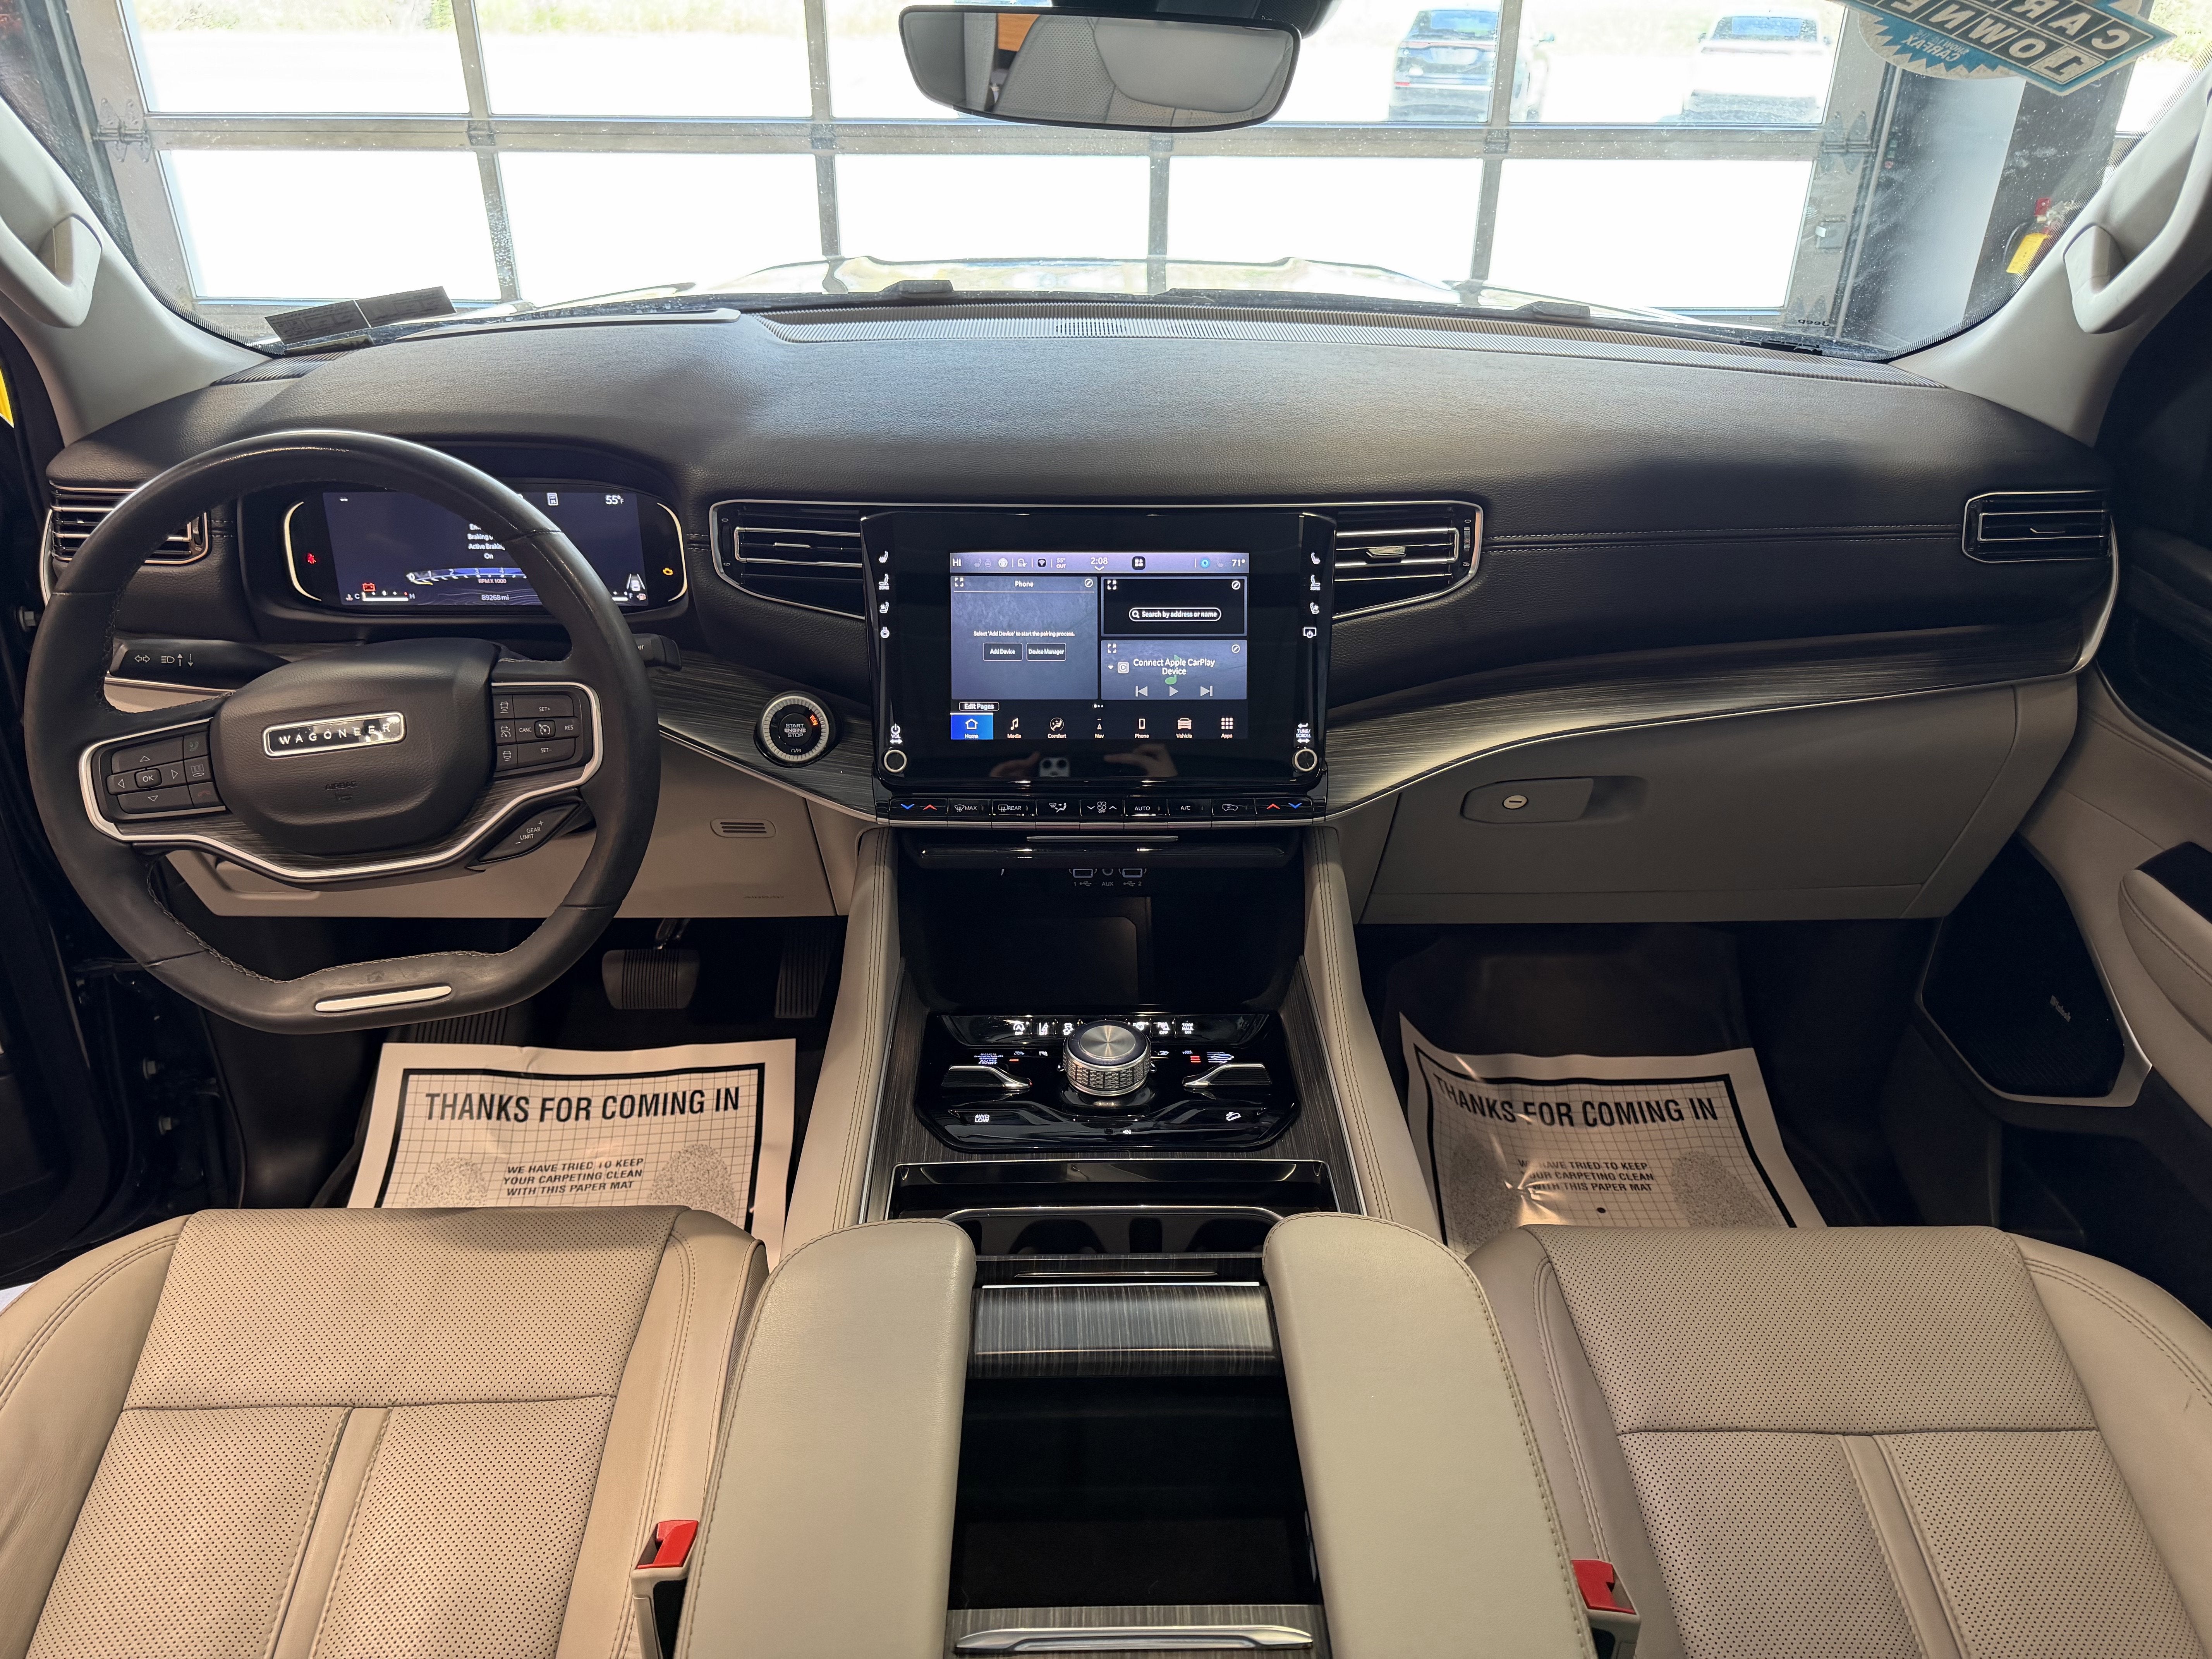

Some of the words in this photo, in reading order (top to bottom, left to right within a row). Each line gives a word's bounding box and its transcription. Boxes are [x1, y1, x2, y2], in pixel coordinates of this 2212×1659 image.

[1165, 658, 1186, 667] Apple
[1187, 658, 1215, 668] CarPlay
[279, 723, 391, 745] WAGONEER
[326, 781, 357, 790] AIRBAG
[426, 1092, 529, 1123] THANKS
[540, 1096, 591, 1123] FOR
[602, 1089, 704, 1119] COMING
[715, 1086, 740, 1112] IN
[1433, 1073, 1516, 1123] THANKS
[1523, 1101, 1575, 1127] FOR
[1582, 1098, 1684, 1127] COMING
[1690, 1097, 1718, 1121] IN
[528, 1164, 558, 1173] HAVE
[562, 1162, 593, 1171] TRIED
[598, 1161, 612, 1169] TO
[616, 1158, 644, 1168] KEEP
[1569, 1161, 1601, 1170] TRIED
[1604, 1162, 1618, 1170] TO
[504, 1176, 535, 1185] YOUR
[539, 1171, 602, 1183] CARPETING
[606, 1169, 642, 1179] CLEAN
[1555, 1172, 1618, 1180] CARPETING
[1619, 1173, 1654, 1181] CLEAN
[507, 1187, 536, 1196] WITH
[541, 1185, 566, 1194] THIS
[570, 1183, 606, 1192] PAPER
[610, 1181, 634, 1190] MAT
[1564, 1183, 1588, 1191] THIS
